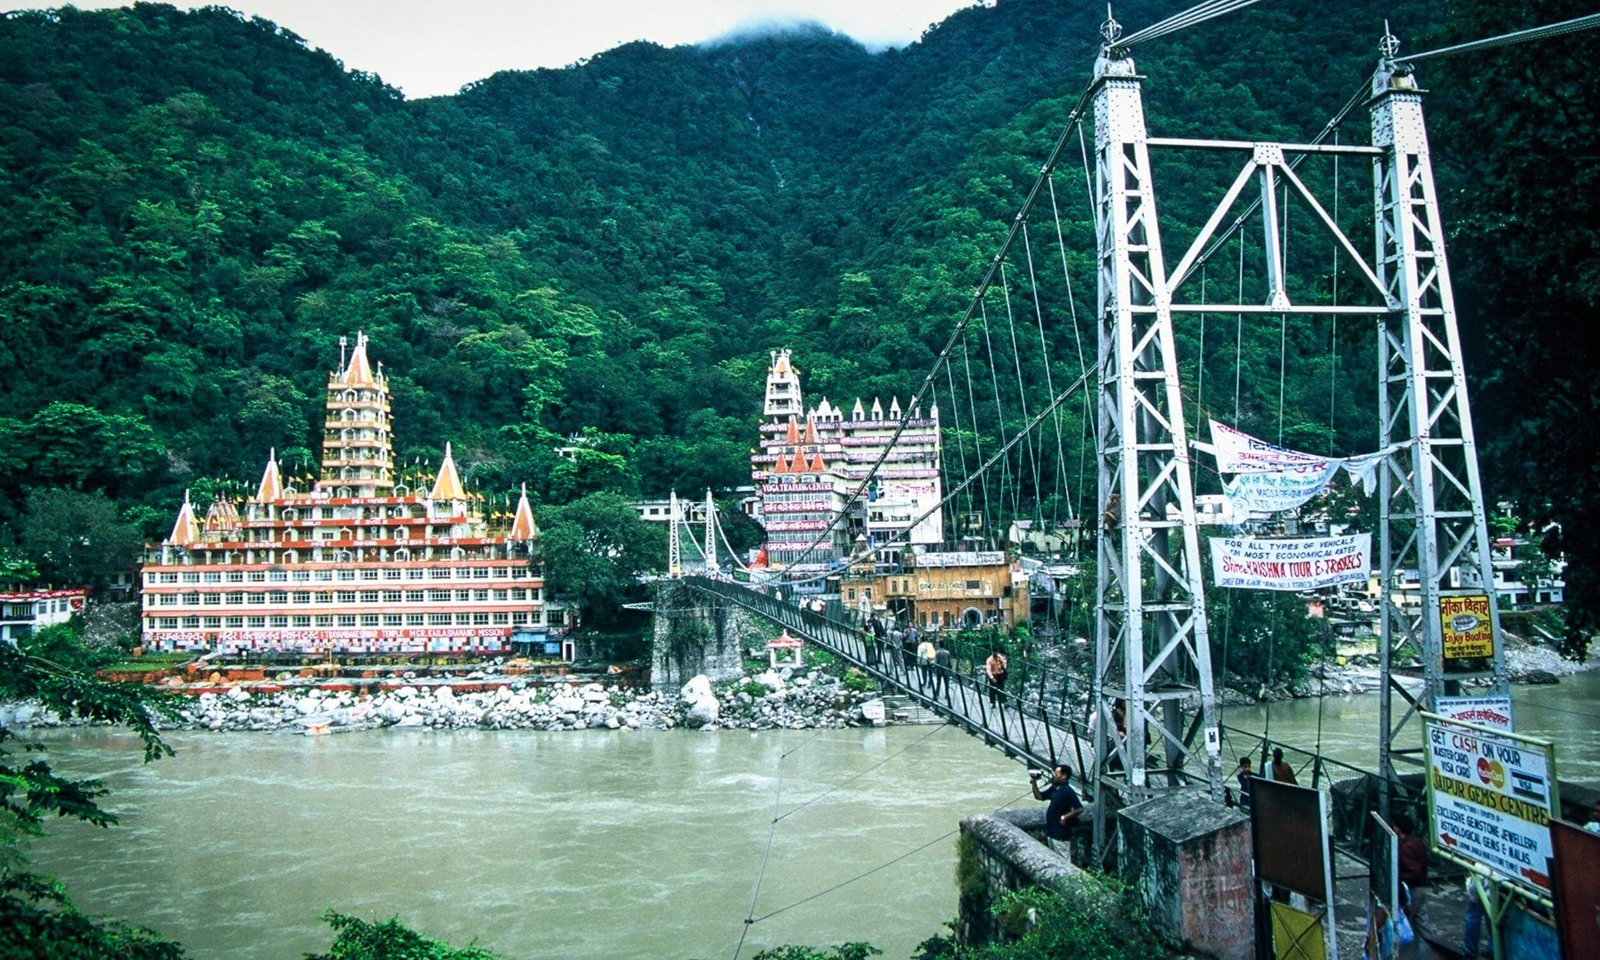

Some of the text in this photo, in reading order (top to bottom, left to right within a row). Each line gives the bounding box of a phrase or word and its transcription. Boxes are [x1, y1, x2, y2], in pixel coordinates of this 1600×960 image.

[763, 484, 780, 492] YOGA
[1225, 540, 1242, 549] FOR
[1248, 542, 1264, 550] ALL
[1320, 536, 1355, 548] VEHICALS
[1244, 551, 1270, 559] MOST
[1275, 549, 1332, 560] ECONOMICAL
[1335, 545, 1356, 555] RATES
[1289, 561, 1312, 578] TOUR
[1315, 560, 1324, 576] &
[1324, 551, 1362, 575] TRAVELS
[1444, 631, 1491, 645] Enjoy Boating
[1431, 729, 1521, 767] GET CASH ON YOUR
[1441, 760, 1455, 773] VISA
[1433, 770, 1465, 798] JAIPUR
[1468, 784, 1497, 809] GEMS
[1500, 795, 1549, 827] CENTRE
[1437, 805, 1466, 824] EXCLUSIVE
[1466, 816, 1500, 838] GEMSTONE
[1501, 829, 1538, 852] JEWELLERY
[1441, 820, 1482, 845] ASTROLOGICAL
[1482, 836, 1500, 853] GEMS
[1502, 843, 1507, 856] &
